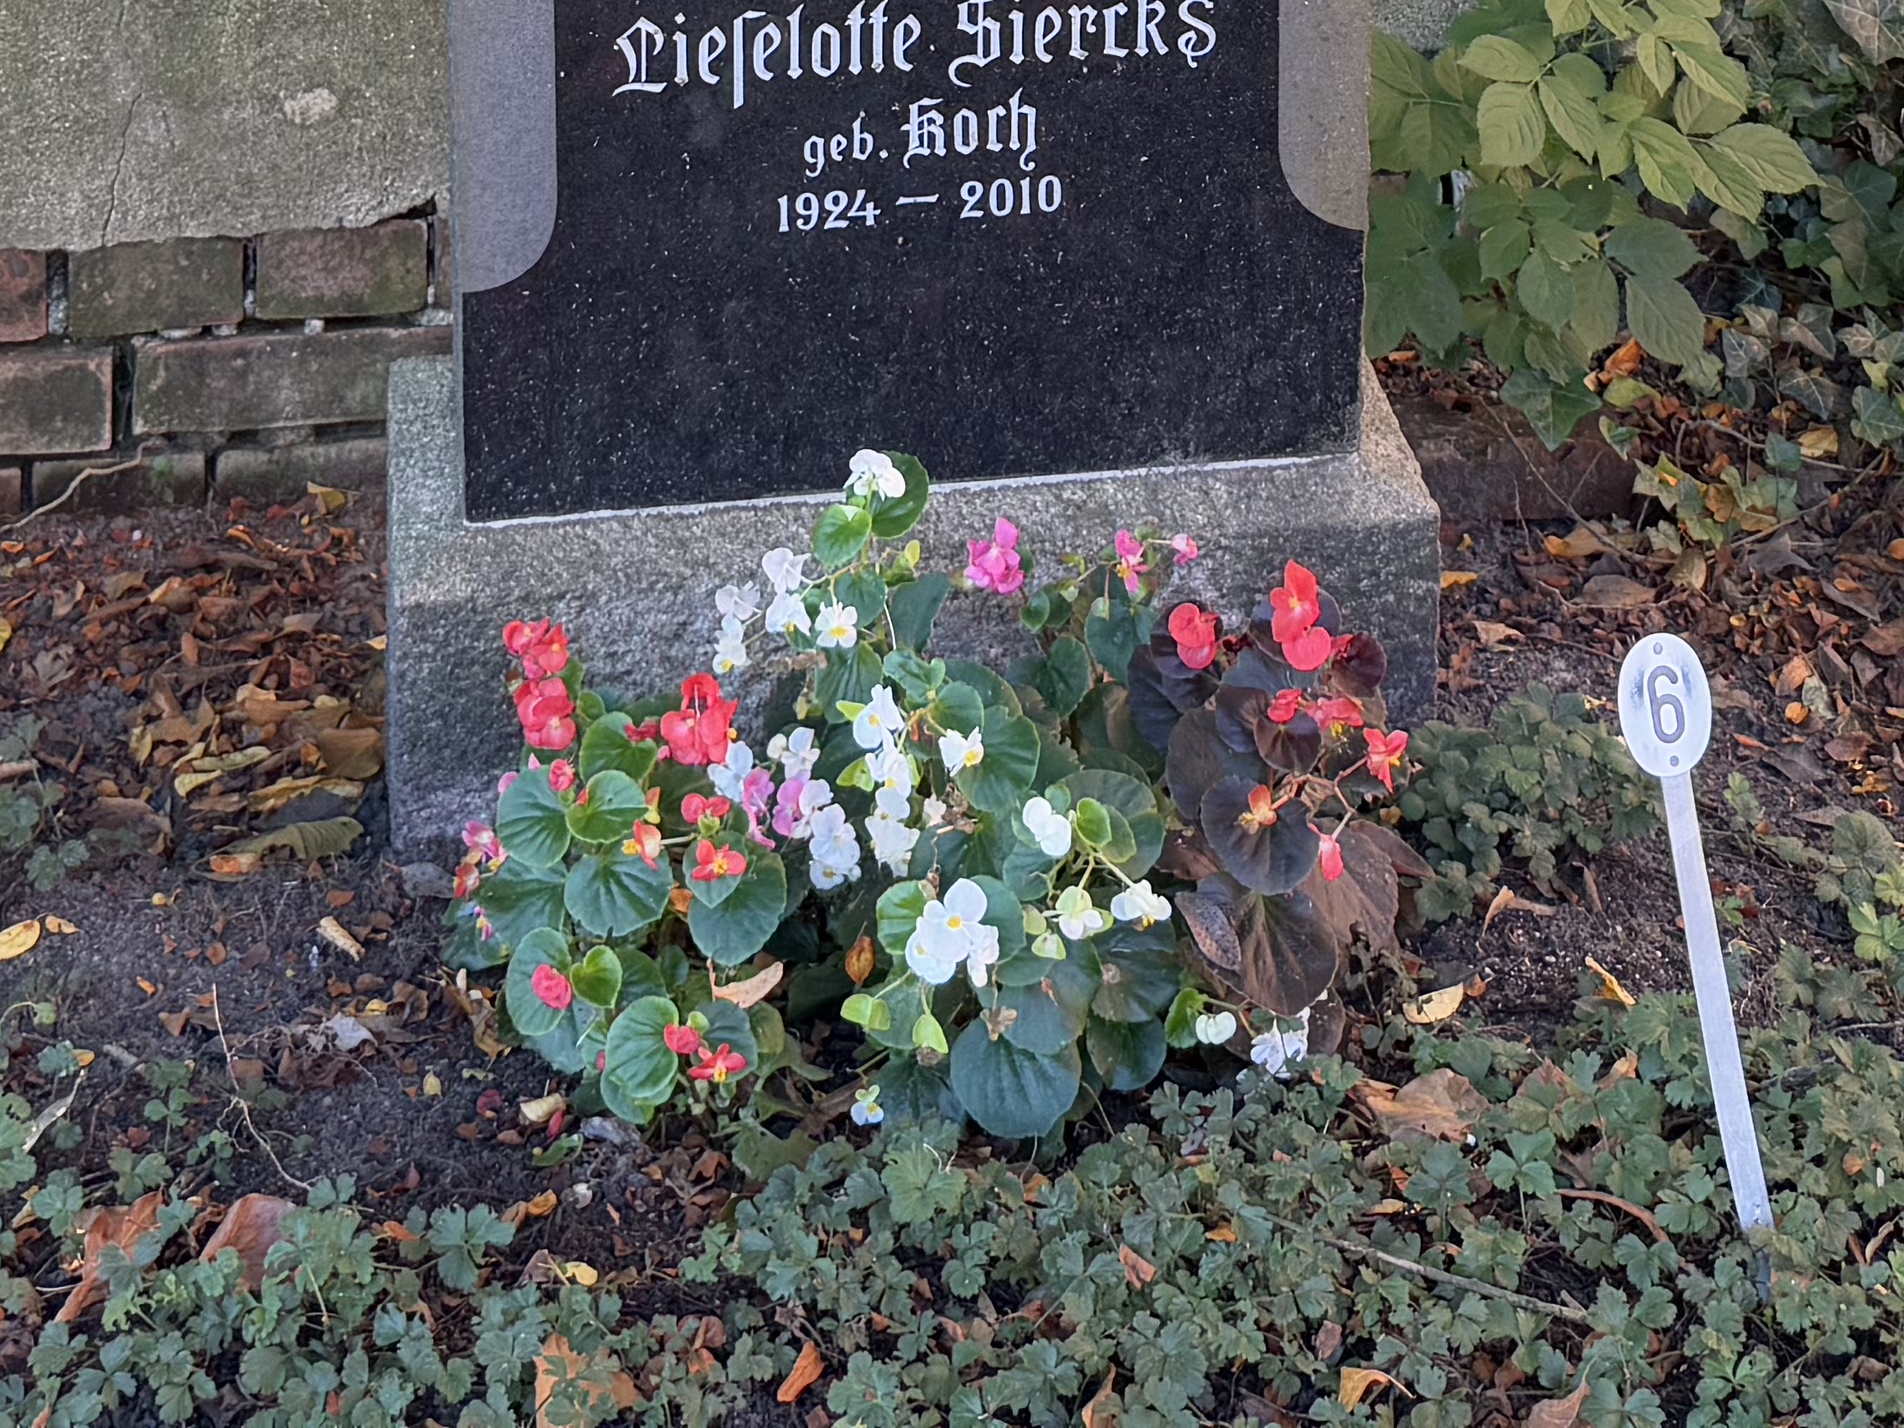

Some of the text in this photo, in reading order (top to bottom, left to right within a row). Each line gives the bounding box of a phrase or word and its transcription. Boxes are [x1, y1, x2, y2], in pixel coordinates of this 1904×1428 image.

[802, 86, 1038, 168] geb. Koch
[776, 188, 883, 234] 1924
[958, 174, 1063, 220] 2010
[1646, 664, 1686, 744] 6
